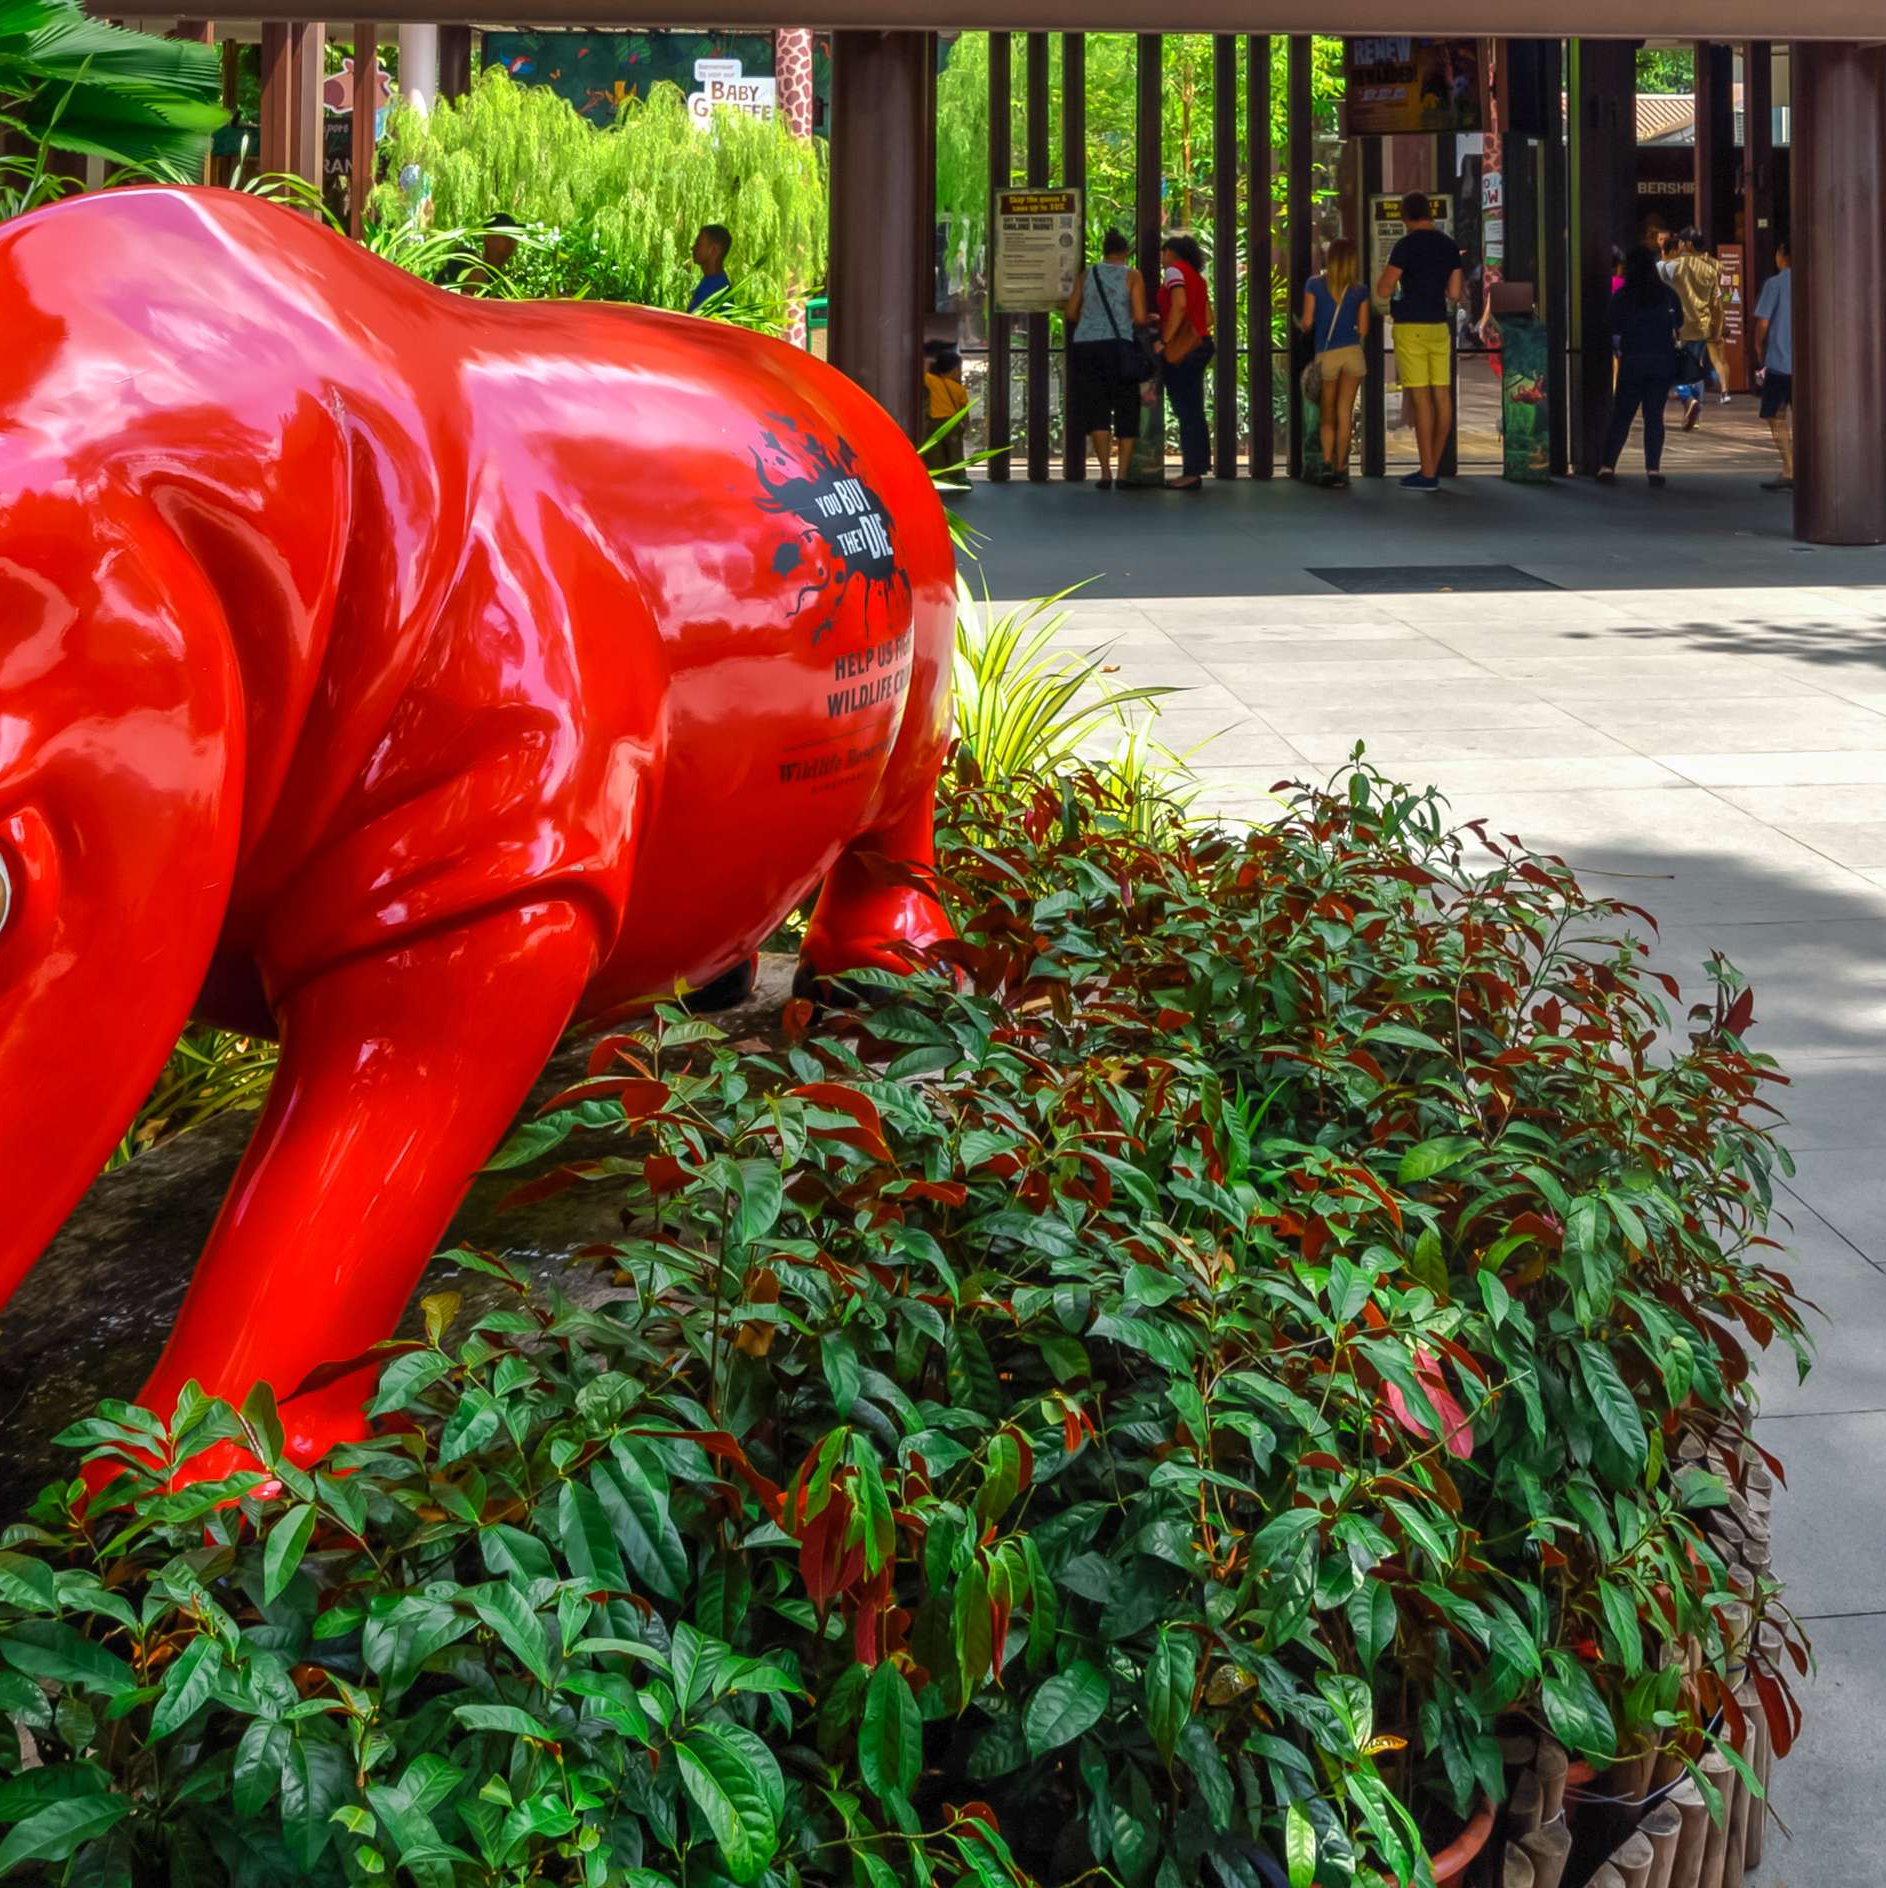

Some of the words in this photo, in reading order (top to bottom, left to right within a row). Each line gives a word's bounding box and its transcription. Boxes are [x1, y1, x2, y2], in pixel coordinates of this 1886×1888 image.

[711, 80, 759, 102] BABY
[815, 492, 843, 518] YOU
[833, 478, 871, 516] BUY
[836, 528, 867, 556] THEY
[858, 513, 894, 560] DIE
[835, 647, 875, 682] HELP
[877, 639, 893, 668] US
[827, 674, 892, 719] WILDLIFE
